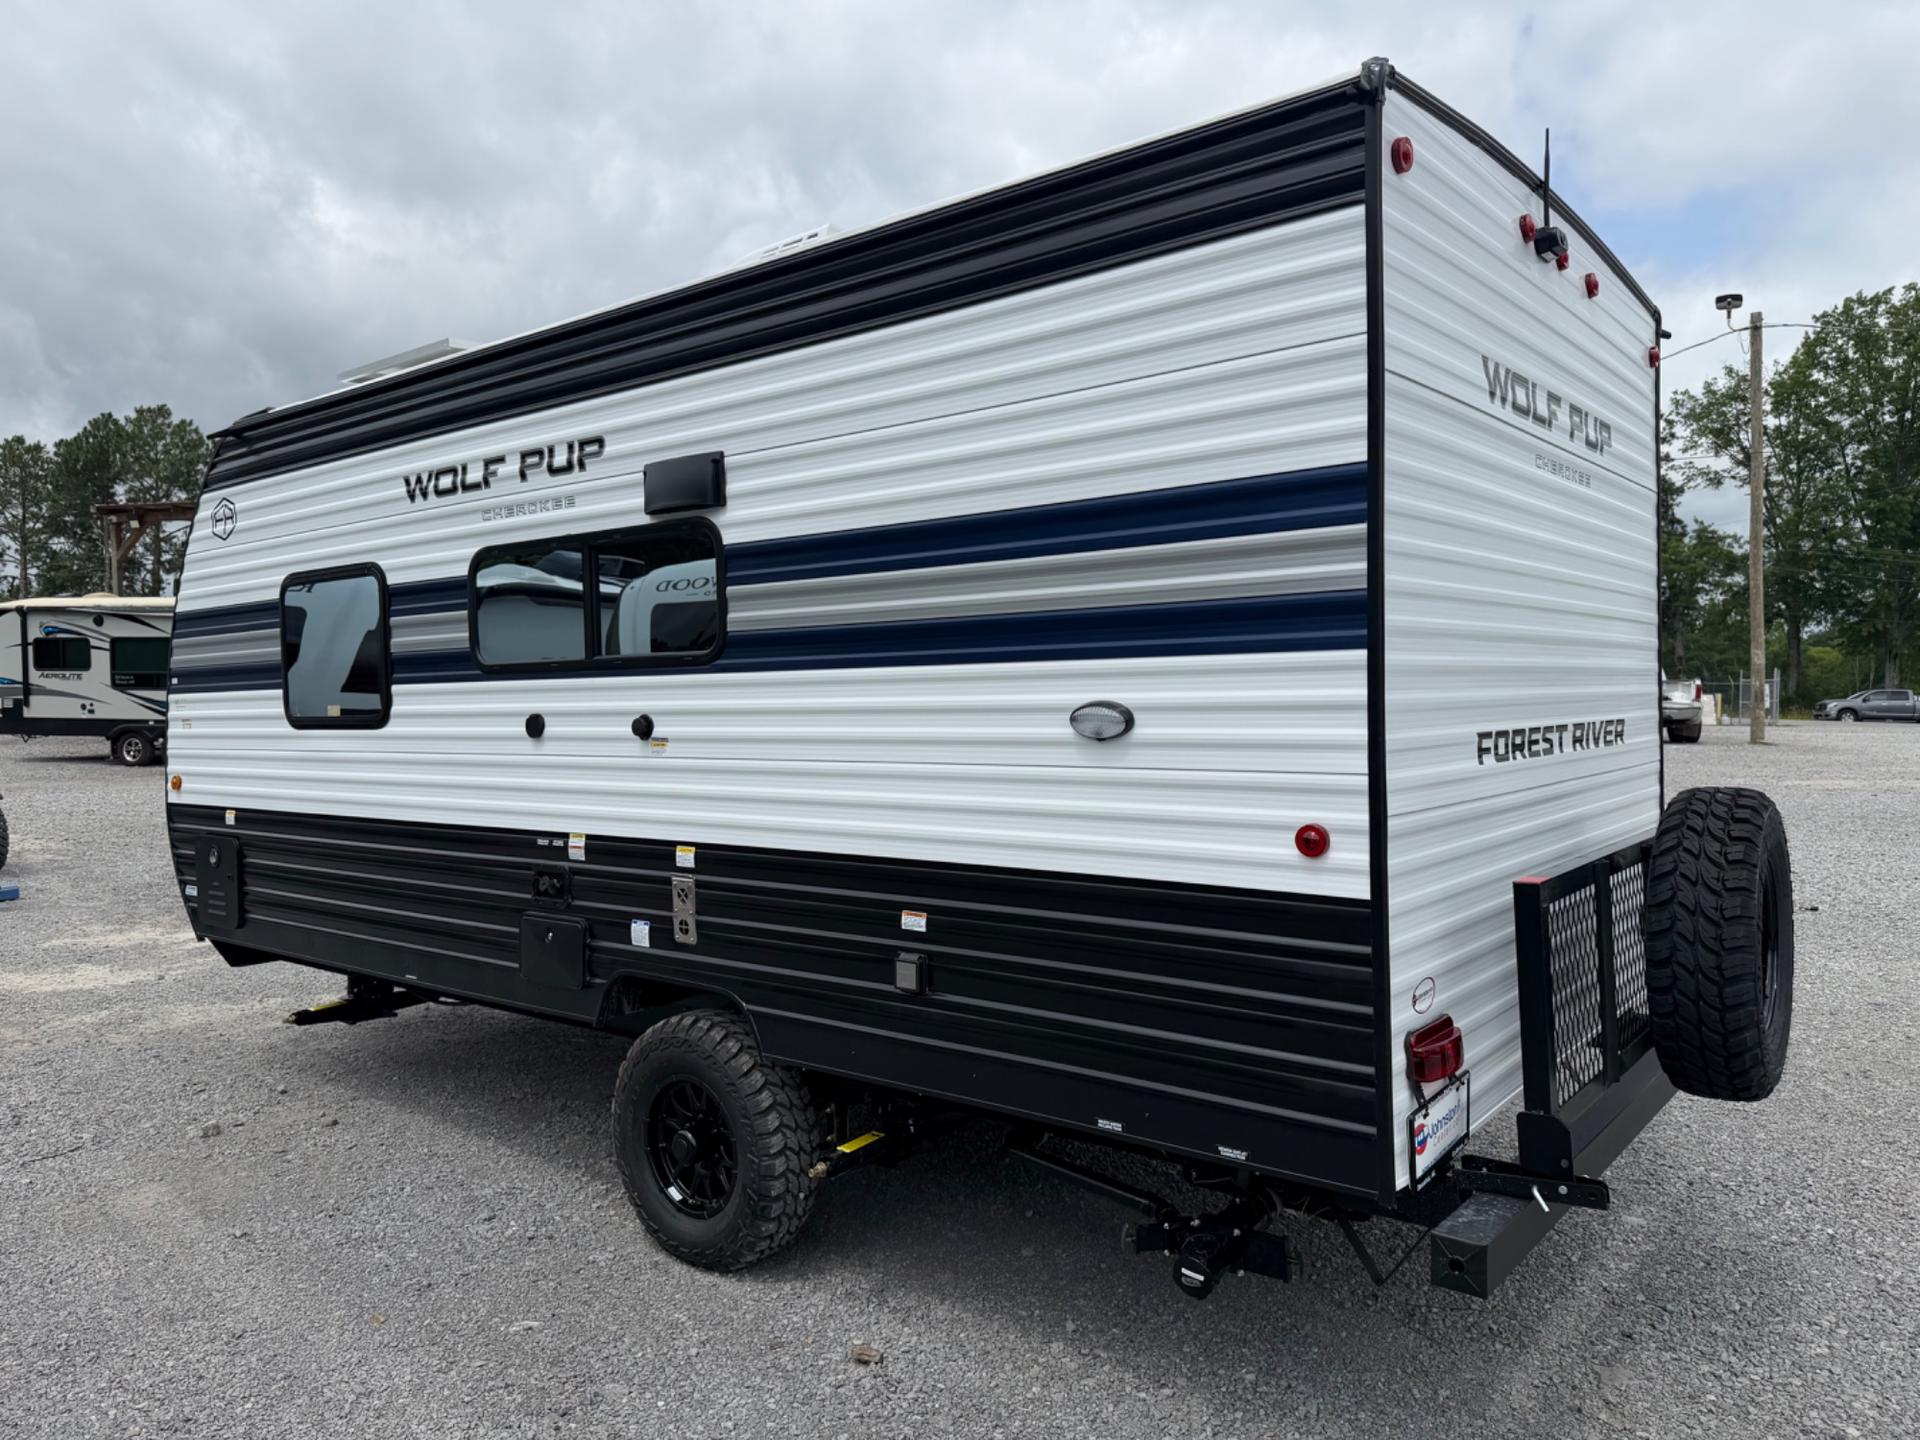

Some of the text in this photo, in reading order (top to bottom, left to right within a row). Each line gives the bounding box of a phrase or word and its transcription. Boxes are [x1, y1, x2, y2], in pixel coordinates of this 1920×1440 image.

[1481, 354, 1613, 457] WOLF PUP
[403, 435, 606, 504] WOLF PUP
[481, 495, 577, 522] CHEROKEE
[1476, 718, 1625, 766] FOREST RIVER
